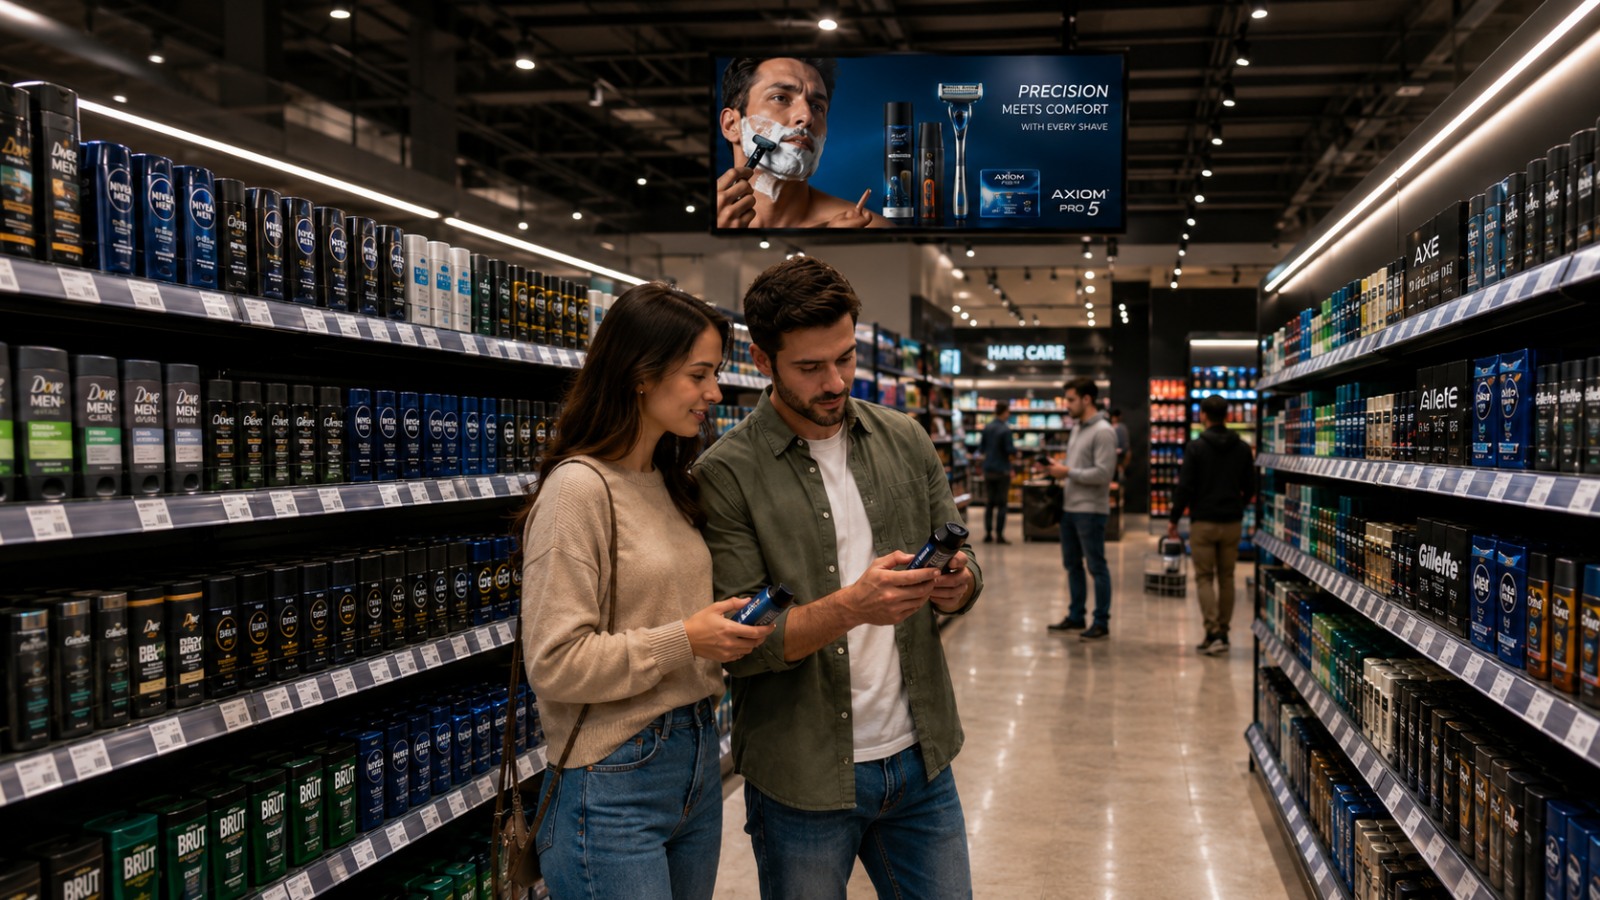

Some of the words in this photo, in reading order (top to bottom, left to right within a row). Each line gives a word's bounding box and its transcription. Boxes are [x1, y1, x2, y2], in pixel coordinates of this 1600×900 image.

[1018, 84, 1109, 98] PRECISION
[1002, 104, 1042, 115] MEETS
[1046, 104, 1109, 115] COMFORT
[1021, 122, 1045, 131] WITH
[1047, 122, 1076, 131] EVERY
[1078, 122, 1109, 131] SHAVE
[52, 157, 77, 176] MEN
[994, 173, 1025, 181] AXIOM
[110, 181, 132, 197] NIVEA
[152, 190, 175, 204] NIVEA
[1051, 189, 1106, 200] AXIOM
[192, 200, 215, 214] NIVEA
[1059, 204, 1085, 213] PRO
[1086, 201, 1101, 216] 5
[1413, 235, 1440, 268] AXE
[987, 344, 1024, 361] HAIR
[1025, 344, 1066, 361] CARE
[30, 375, 64, 394] Dove
[87, 383, 116, 401] Dove
[135, 386, 160, 404] Dove
[1418, 543, 1459, 581] Gillette
[335, 765, 356, 790] BRUT
[299, 778, 322, 805] BRUT
[261, 792, 286, 820] BRUT
[220, 808, 246, 839] BRUT
[177, 825, 207, 857] BRUT
[123, 845, 157, 880] BRUT
[63, 867, 101, 900] BRUT
